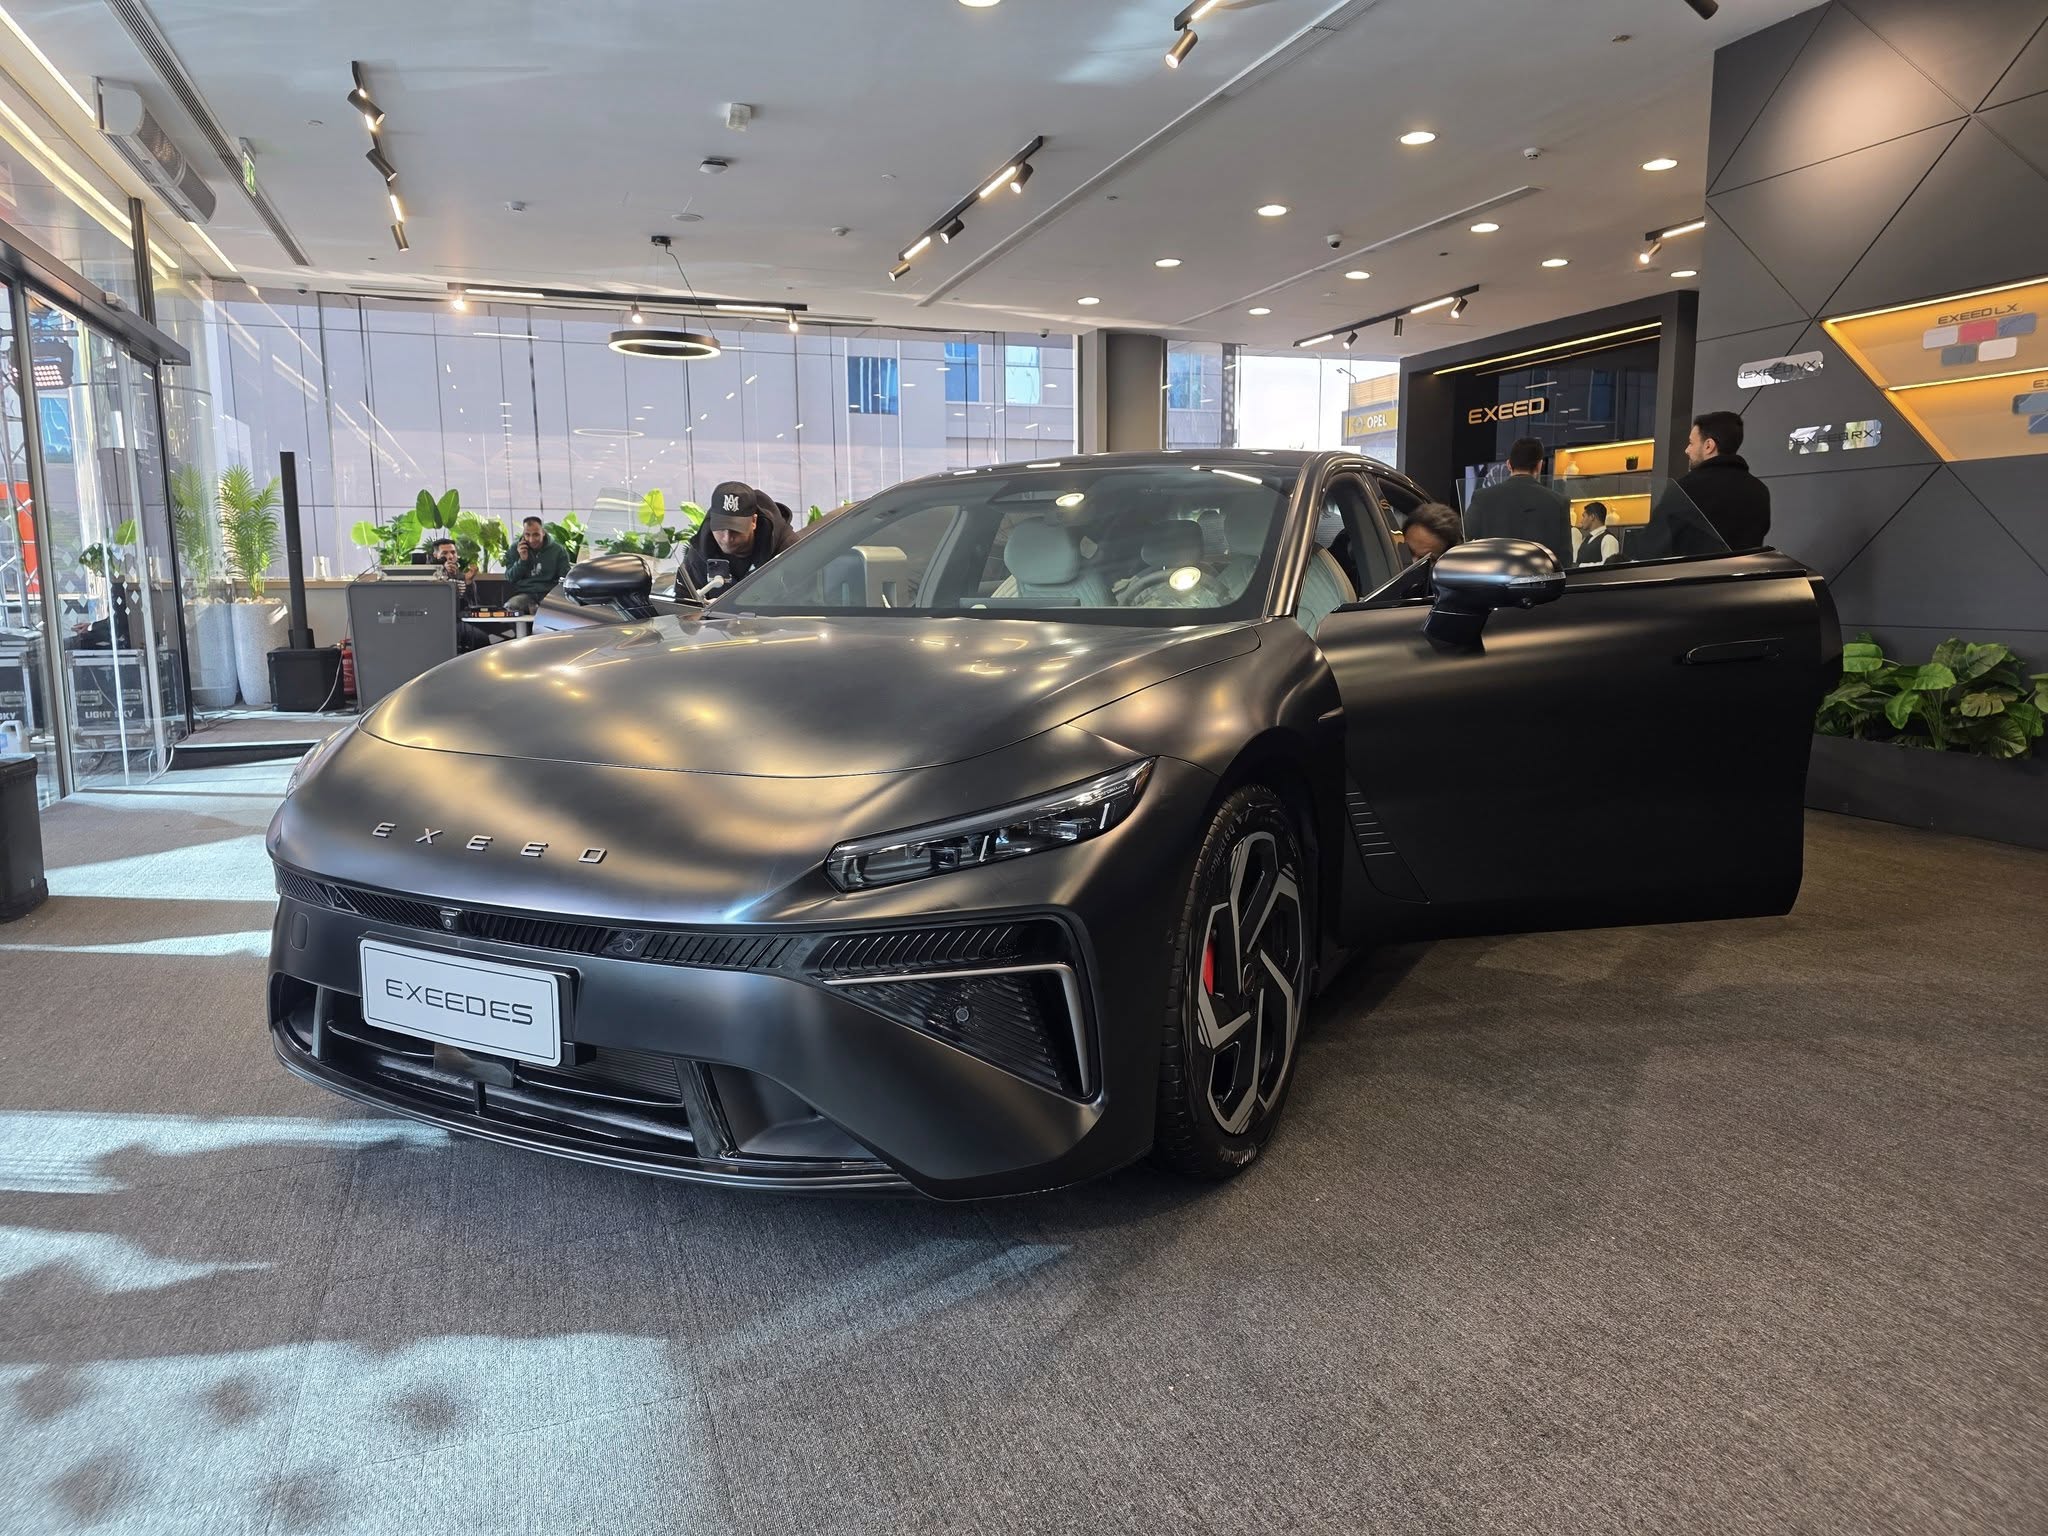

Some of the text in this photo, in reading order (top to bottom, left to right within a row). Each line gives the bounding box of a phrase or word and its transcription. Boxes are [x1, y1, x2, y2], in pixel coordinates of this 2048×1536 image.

[1937, 303, 2018, 325] EXEED LX
[1796, 360, 1817, 371] VX
[1467, 397, 1546, 425] EXEED
[1366, 413, 1388, 429] OPEL
[1851, 429, 1874, 440] RX
[84, 710, 112, 719] LIGHT
[371, 821, 609, 865] EXEED
[385, 978, 534, 1026] EXEEDES
